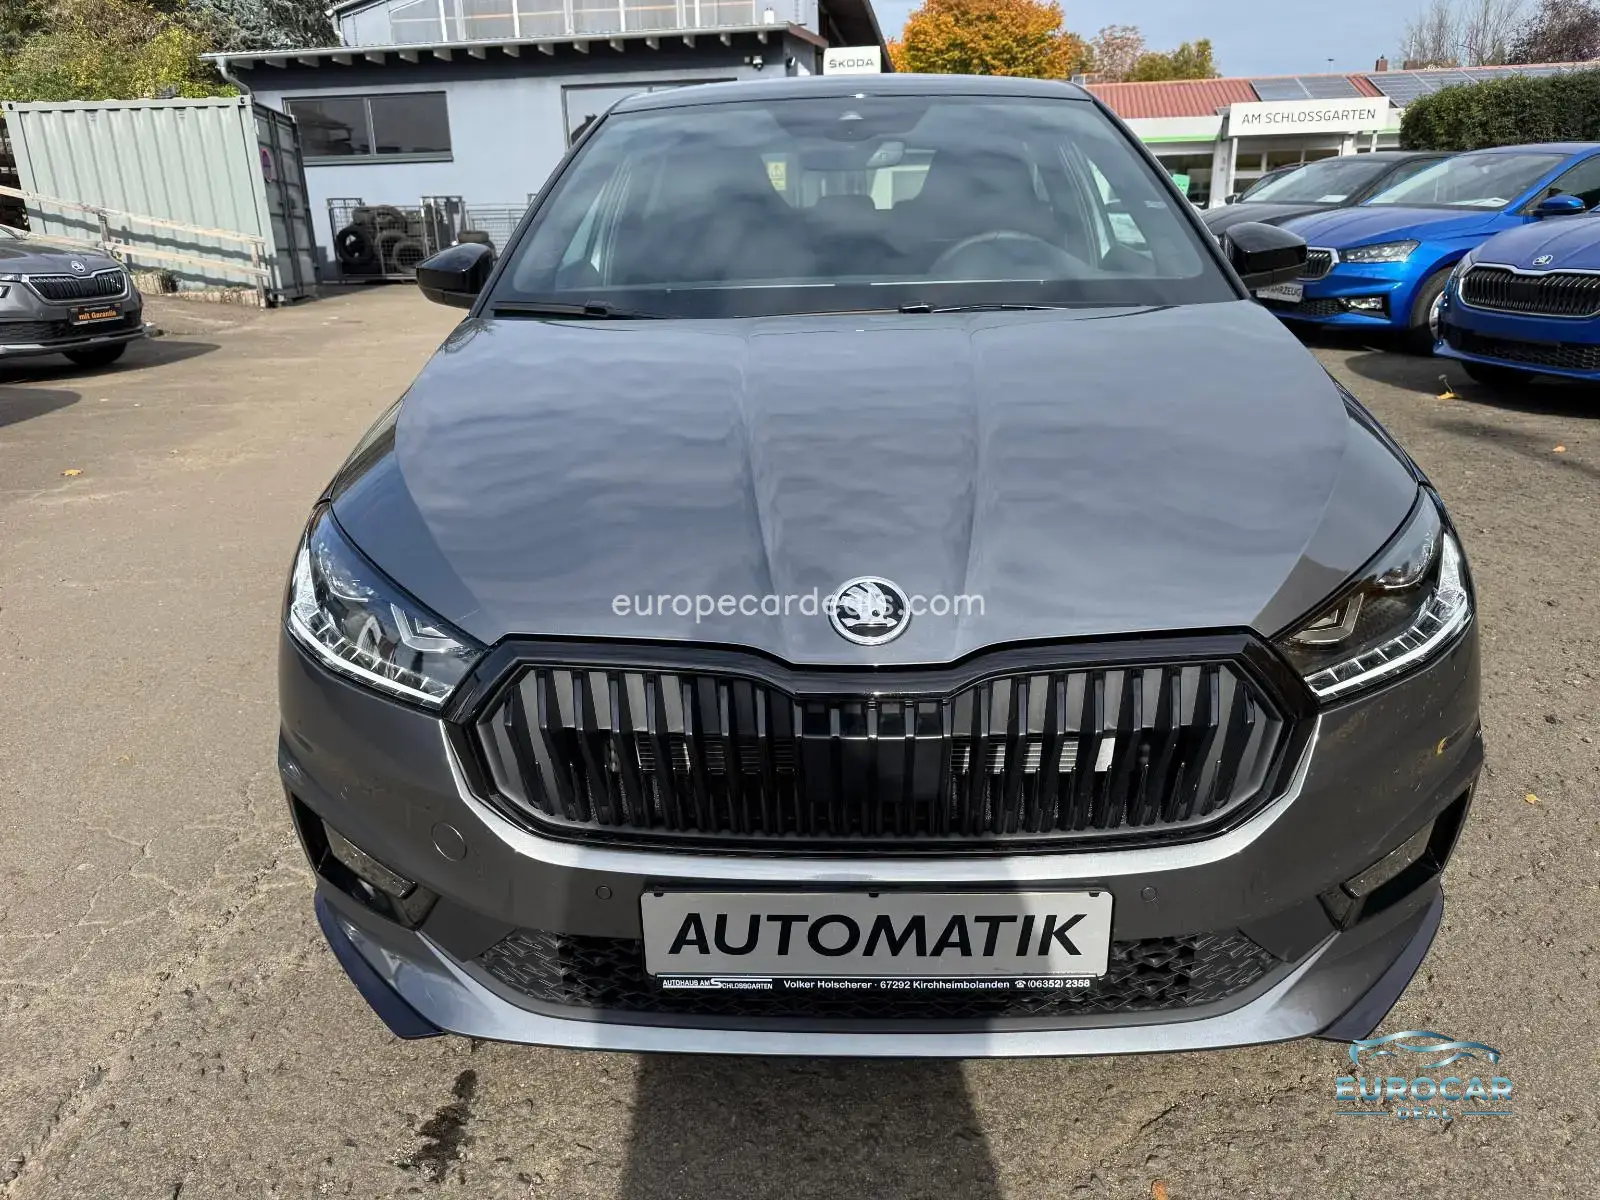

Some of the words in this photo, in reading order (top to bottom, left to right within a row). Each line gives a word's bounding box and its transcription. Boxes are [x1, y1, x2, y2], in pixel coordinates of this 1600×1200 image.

[1242, 114, 1261, 125] AM
[1265, 109, 1377, 124] SCHLOSSGARTEN
[668, 912, 1088, 956] AUTOMATIK
[784, 979, 815, 989] Volker
[817, 980, 873, 990] Holscherer
[880, 980, 911, 990] 67292
[913, 980, 1010, 990] Kirchheimbolanden
[1027, 979, 1064, 990] (06352)
[1065, 979, 1091, 989] 2358
